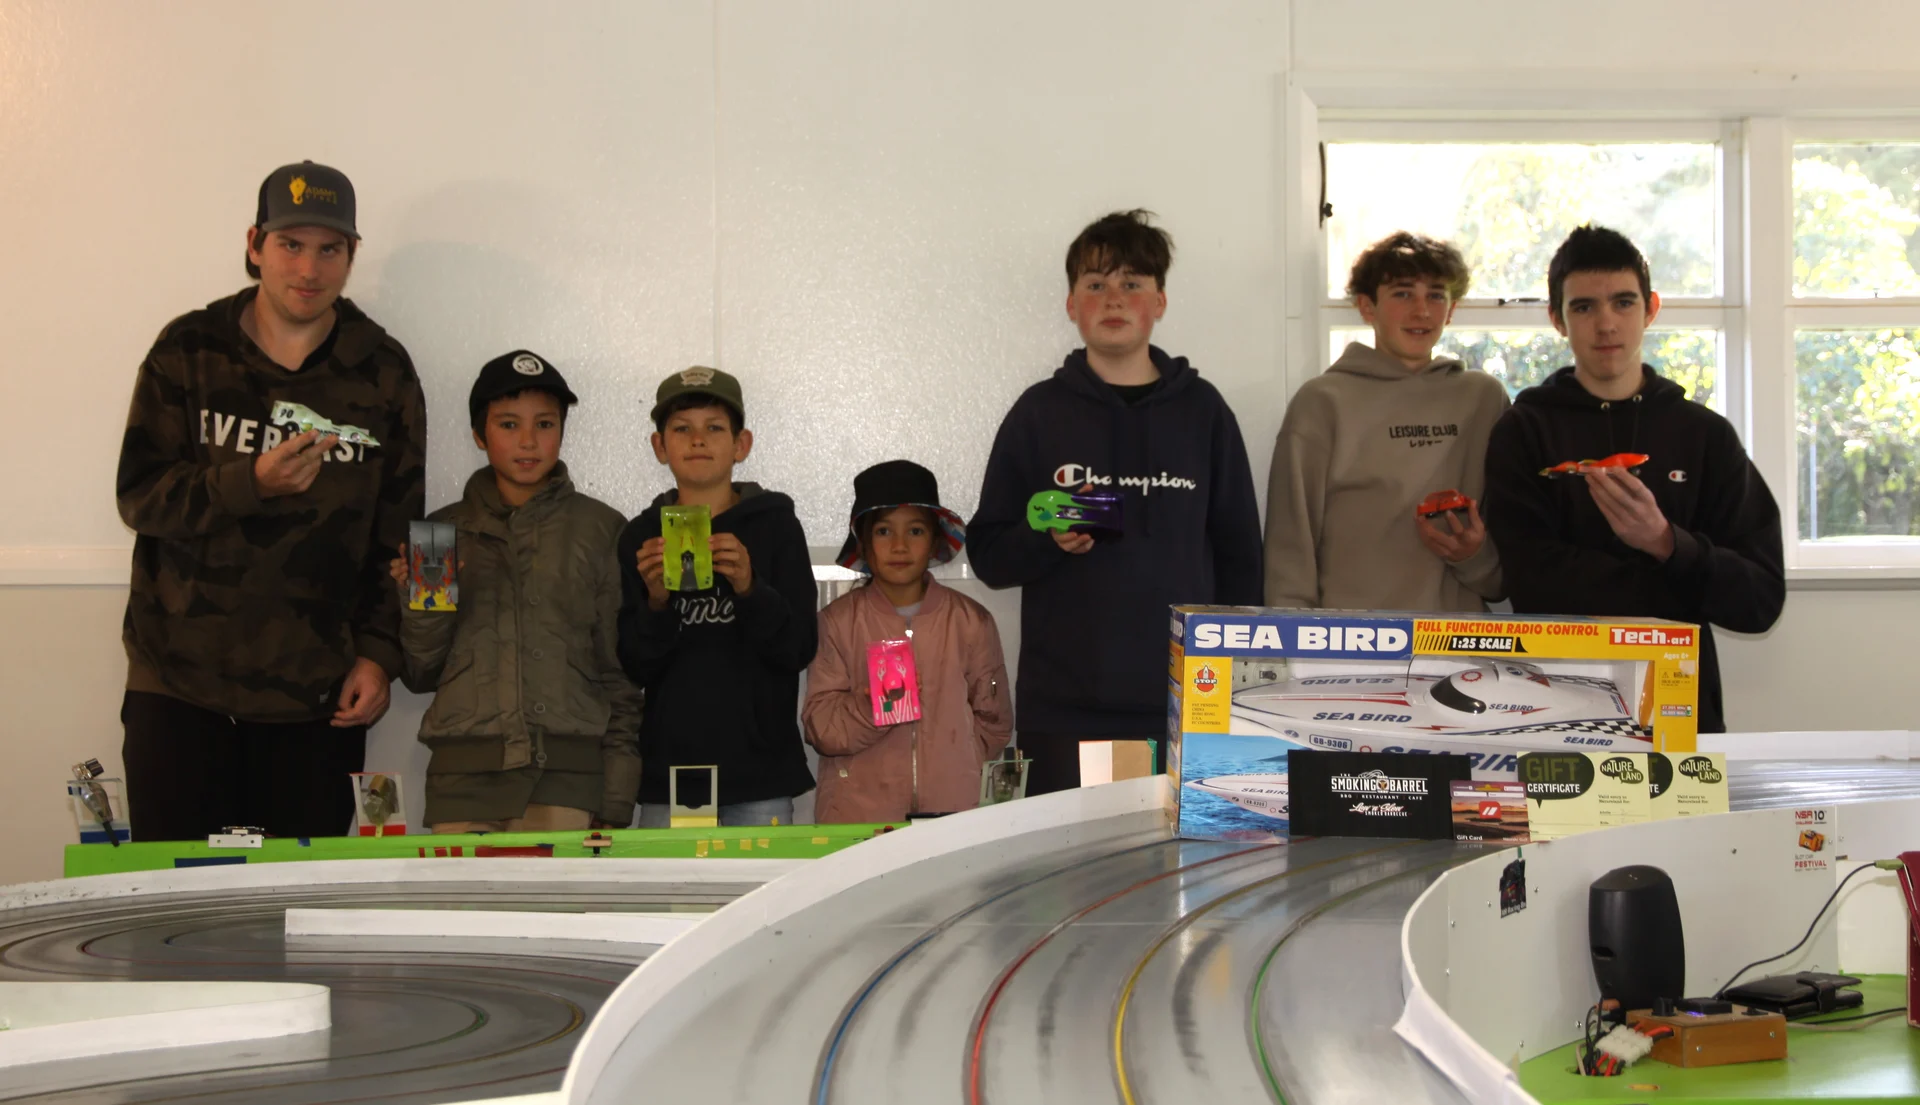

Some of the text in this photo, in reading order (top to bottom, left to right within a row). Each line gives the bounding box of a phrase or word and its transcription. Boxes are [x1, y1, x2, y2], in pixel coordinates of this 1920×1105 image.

[200, 409, 369, 462] EVERS
[1389, 424, 1458, 439] LEISURE CLUB
[1053, 463, 1196, 496] Champion
[1417, 621, 1599, 636] FULL FUNCTION RADIO CONTROL
[1194, 623, 1408, 651] SEA BIRD
[1452, 637, 1512, 650] 1:25 SCALE
[1509, 704, 1533, 712] BIRD
[1313, 712, 1412, 723] SEA BIRD
[1563, 736, 1613, 746] SEA BIRD
[1465, 752, 1518, 772] BIR
[1601, 759, 1633, 774] NATURE
[1680, 759, 1711, 774] NATURE
[1526, 757, 1579, 782] GIFT
[1620, 771, 1641, 781] LAND
[1700, 771, 1720, 781] LAND
[1331, 778, 1428, 792] SMOKING BARREL
[1527, 783, 1580, 793] CERTIFICATE
[1795, 810, 1813, 819] NSR
[1794, 860, 1827, 868] FESTIVAL
